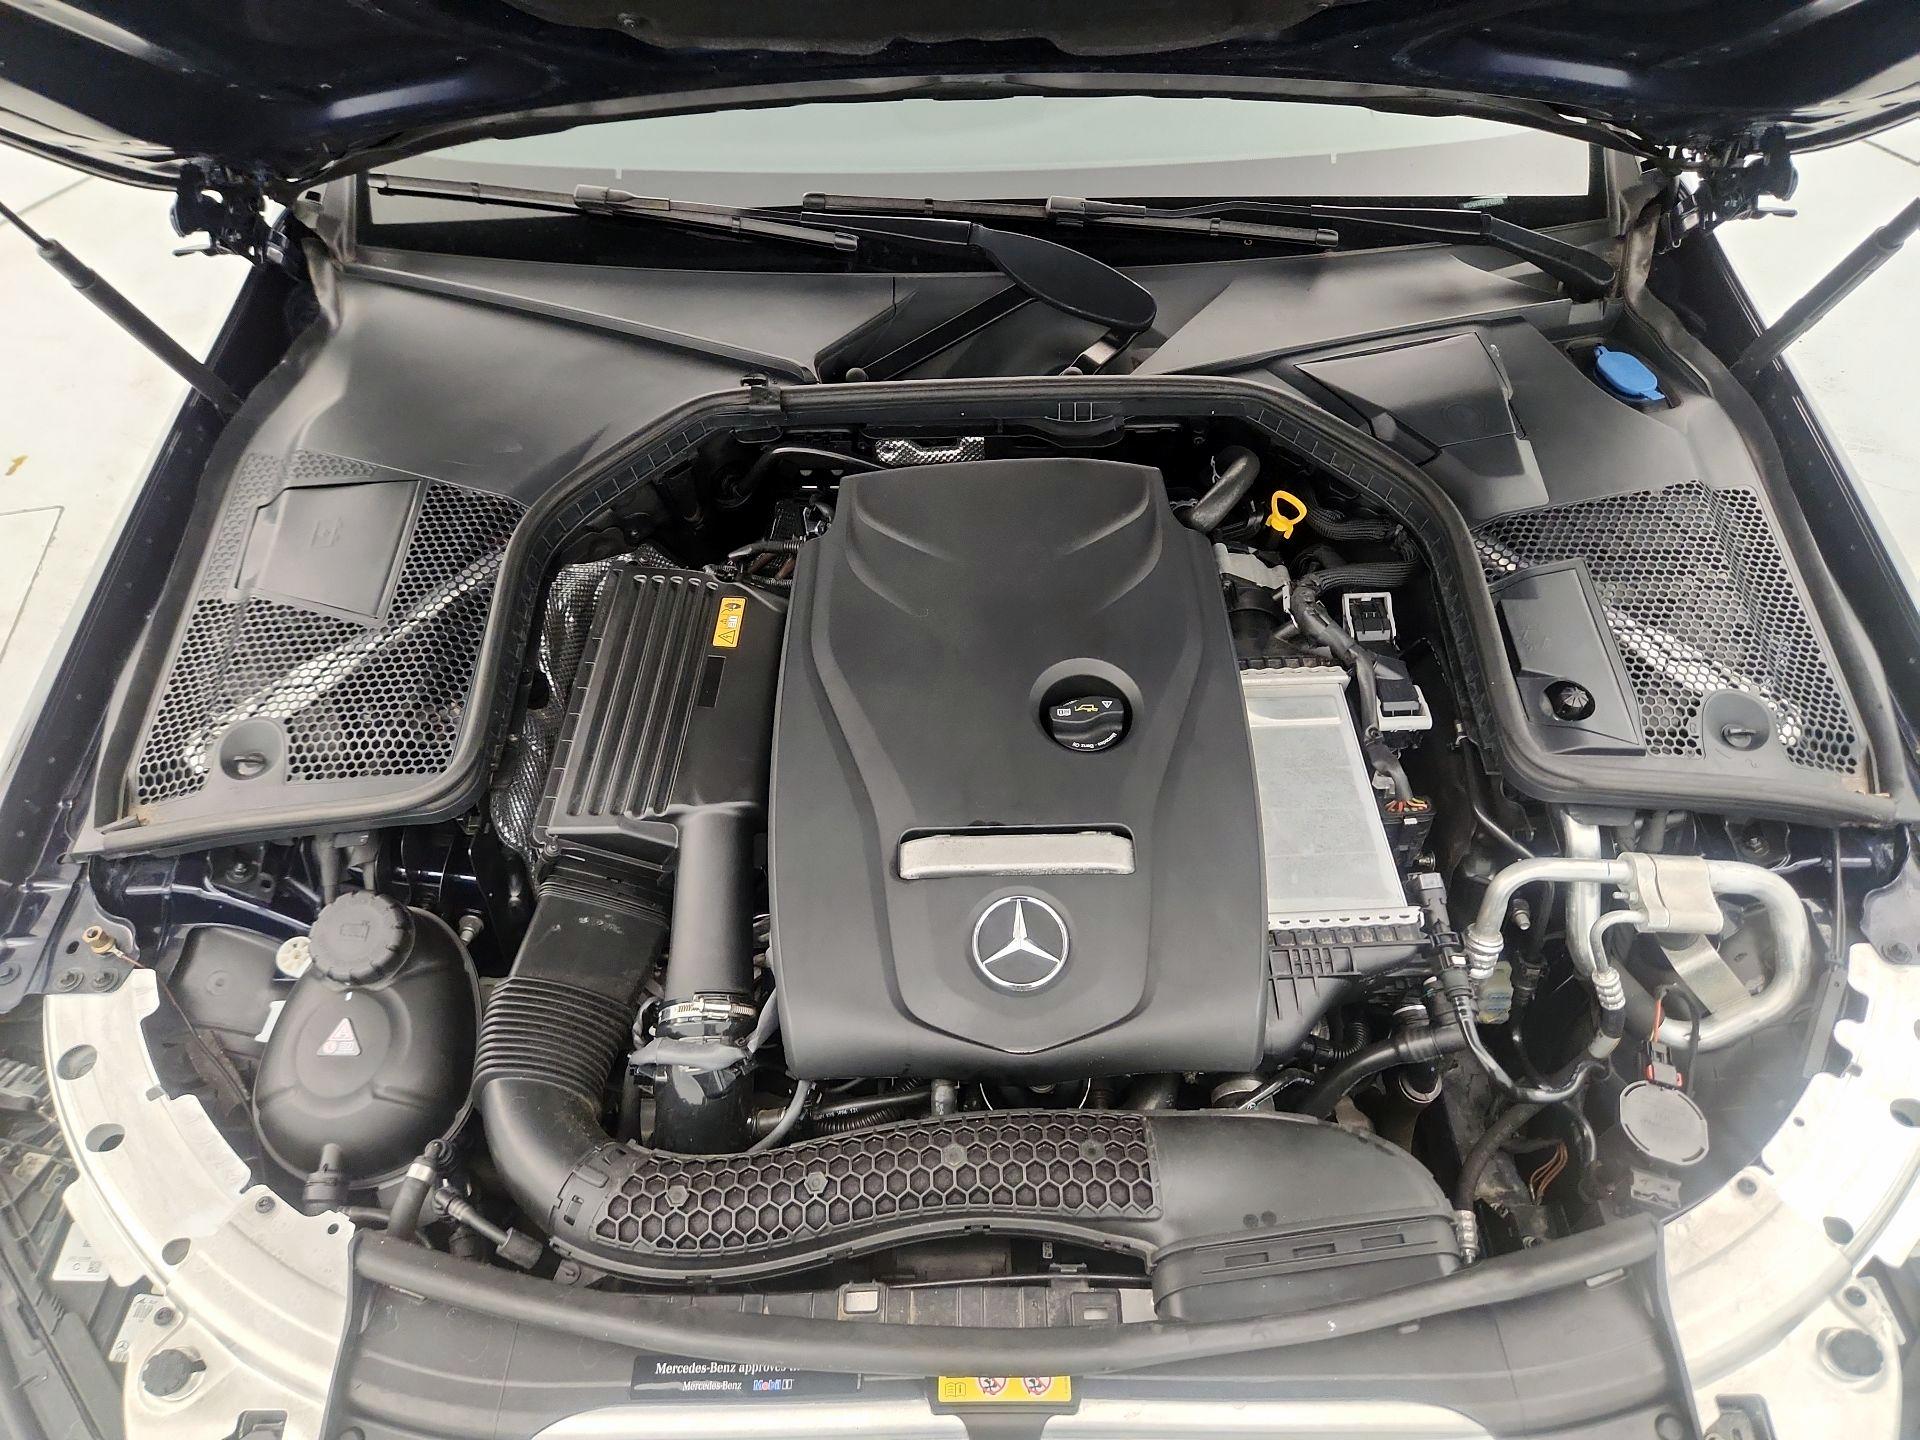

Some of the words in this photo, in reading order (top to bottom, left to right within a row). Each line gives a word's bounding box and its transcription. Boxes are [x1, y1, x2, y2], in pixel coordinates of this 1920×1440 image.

[655, 1362, 736, 1375] Mercedes-Benz
[682, 1380, 742, 1391] Mercedes-Benz
[753, 1379, 781, 1391] Mobil
